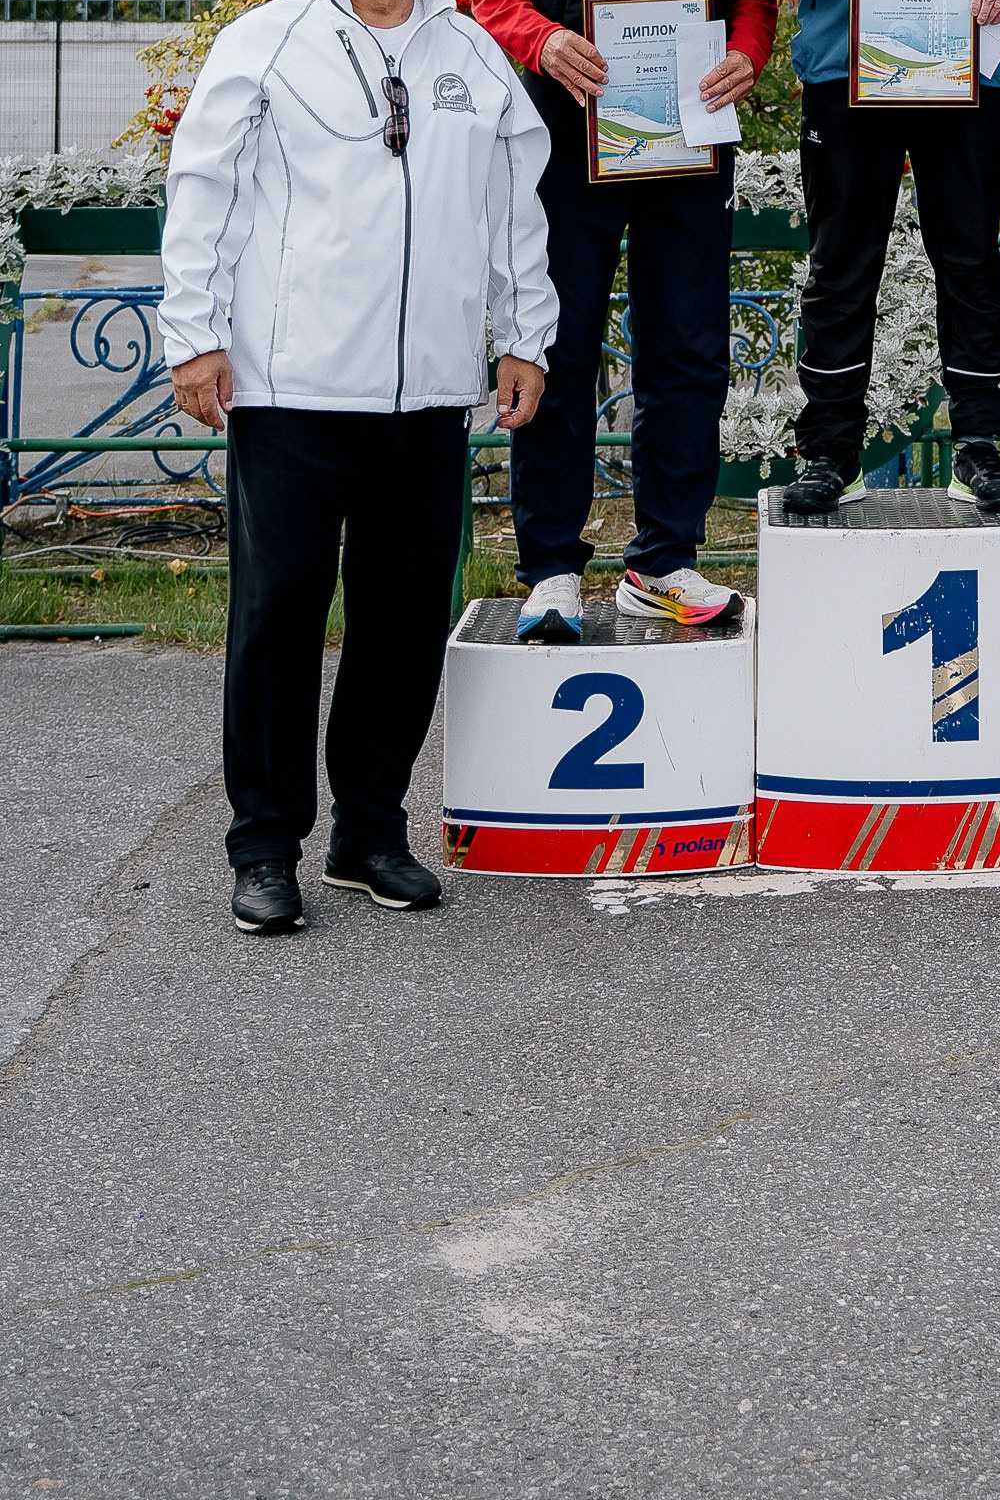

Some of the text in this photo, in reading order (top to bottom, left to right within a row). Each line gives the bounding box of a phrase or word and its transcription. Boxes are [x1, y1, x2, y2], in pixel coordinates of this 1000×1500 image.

[622, 24, 678, 40] ДИПЛОМ
[635, 65, 641, 74] 2
[881, 569, 979, 743] 1
[547, 672, 645, 790] 2
